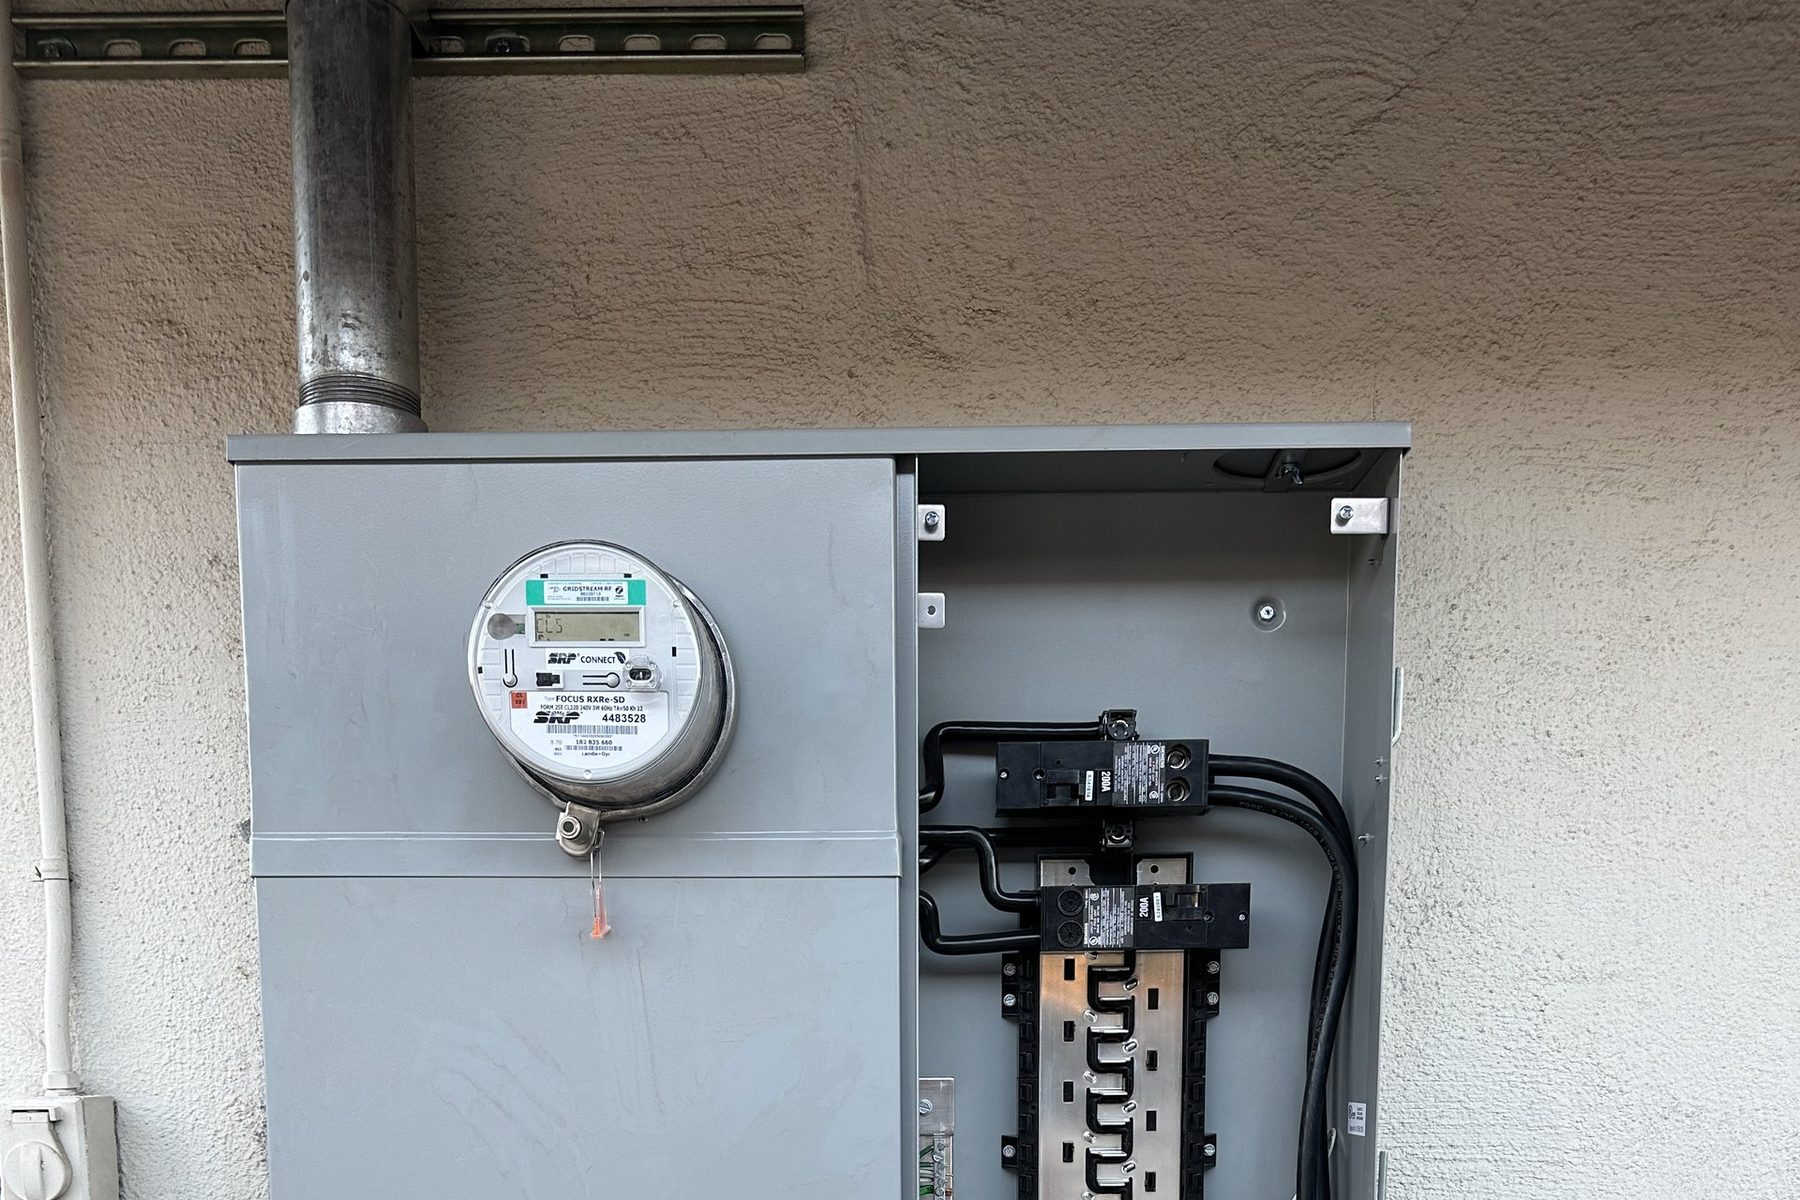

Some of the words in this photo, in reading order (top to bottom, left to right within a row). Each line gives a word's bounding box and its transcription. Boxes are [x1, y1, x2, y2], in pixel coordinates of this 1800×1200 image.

[548, 652, 577, 664] SRP
[580, 656, 616, 664] CONNECT
[556, 695, 585, 703] FOCUS
[587, 695, 625, 703] RXRe-SD
[533, 710, 580, 724] SRP
[602, 713, 646, 723] 4483528
[1101, 771, 1111, 792] 200A
[1139, 897, 1149, 918] 200A
